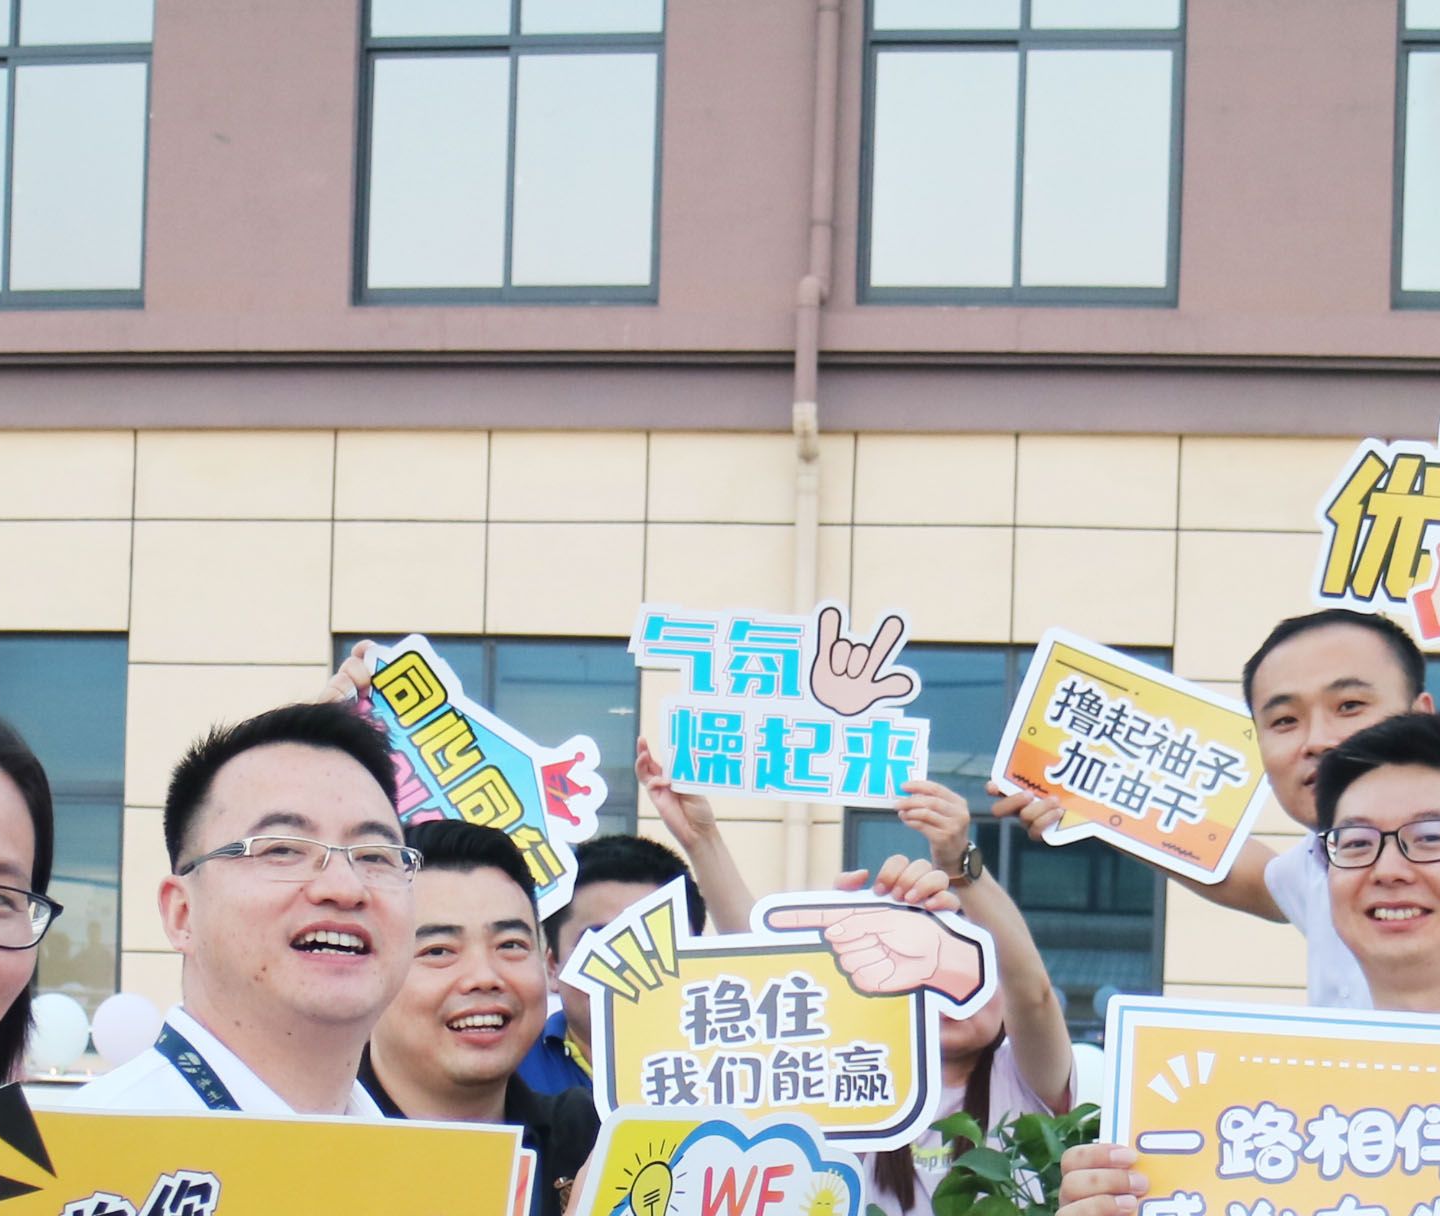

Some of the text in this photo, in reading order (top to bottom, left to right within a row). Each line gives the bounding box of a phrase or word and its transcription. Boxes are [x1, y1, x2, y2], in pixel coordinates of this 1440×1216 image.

[641, 614, 805, 699] 气氛
[668, 706, 921, 798] 燥起来
[1049, 680, 1243, 791] 撸起袖子
[1050, 741, 1199, 828] 加油干
[683, 976, 826, 1046] 稳住
[645, 1046, 891, 1105] 我们能赢
